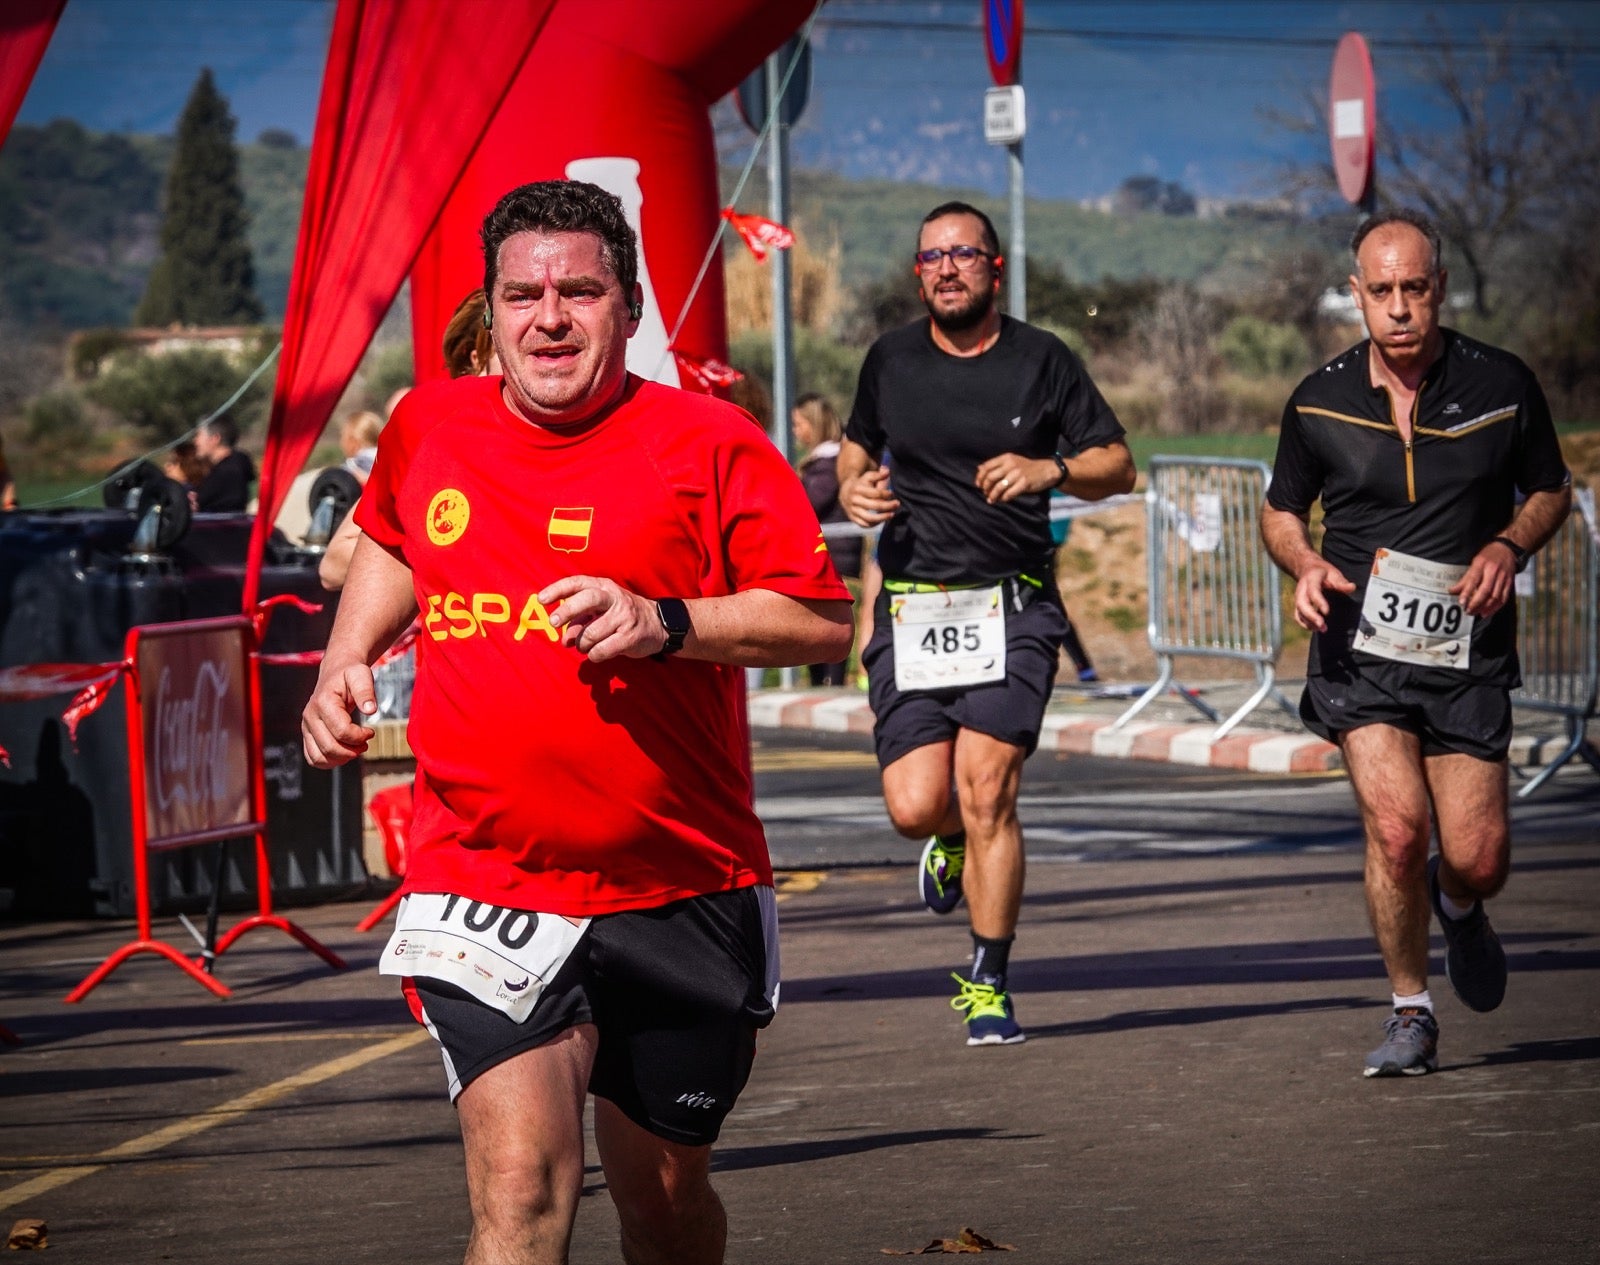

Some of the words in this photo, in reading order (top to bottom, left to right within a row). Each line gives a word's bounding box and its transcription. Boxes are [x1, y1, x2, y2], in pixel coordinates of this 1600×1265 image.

[425, 591, 573, 641] ESPA
[1378, 592, 1462, 634] 3109
[921, 624, 980, 654] 485
